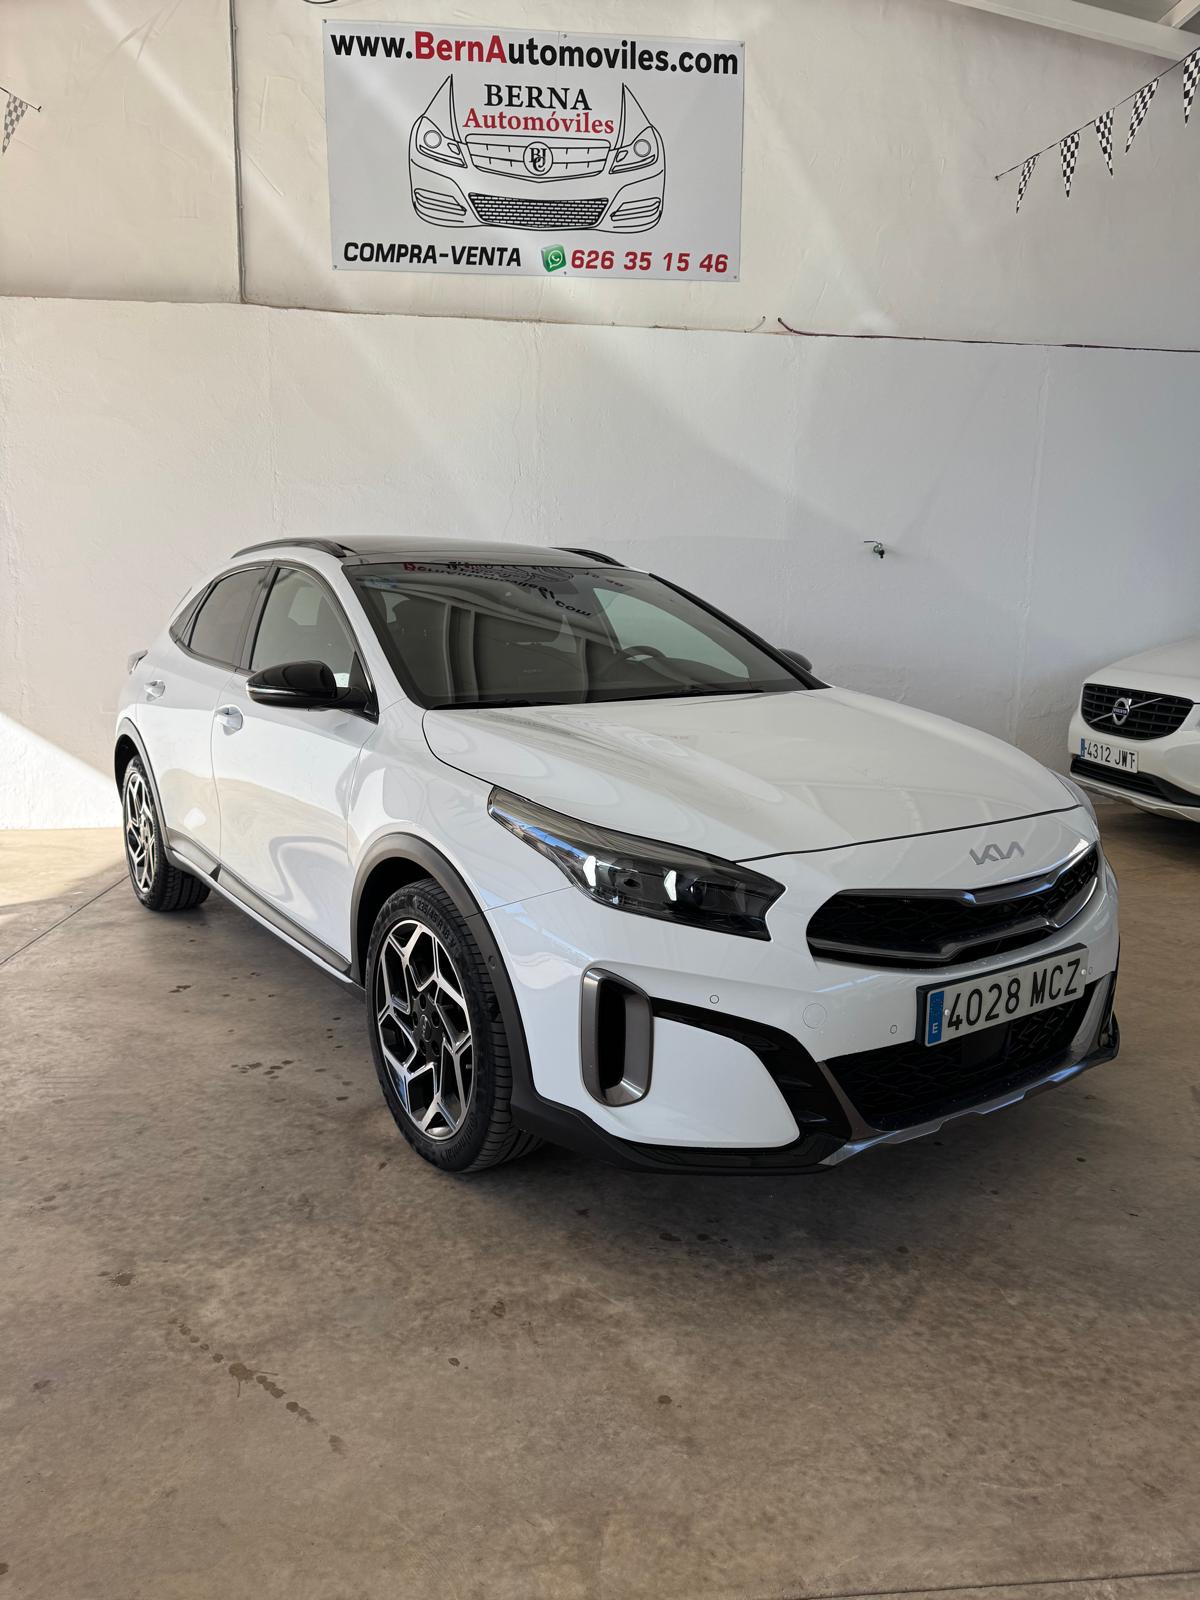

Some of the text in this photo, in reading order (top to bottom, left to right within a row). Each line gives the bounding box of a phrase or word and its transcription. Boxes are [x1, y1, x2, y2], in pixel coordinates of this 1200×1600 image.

[330, 31, 738, 75] www.BernAutomoviles.com
[484, 83, 592, 111] BERNA
[463, 107, 614, 134] Automóviles
[343, 241, 522, 267] COMPRA-VENTA
[571, 249, 728, 273] 626 35 15 46
[1087, 742, 1134, 769] 4312 JWT
[969, 841, 1025, 865] KIA
[947, 958, 1081, 1031] 4028 MCZ
[932, 1023, 939, 1034] E
